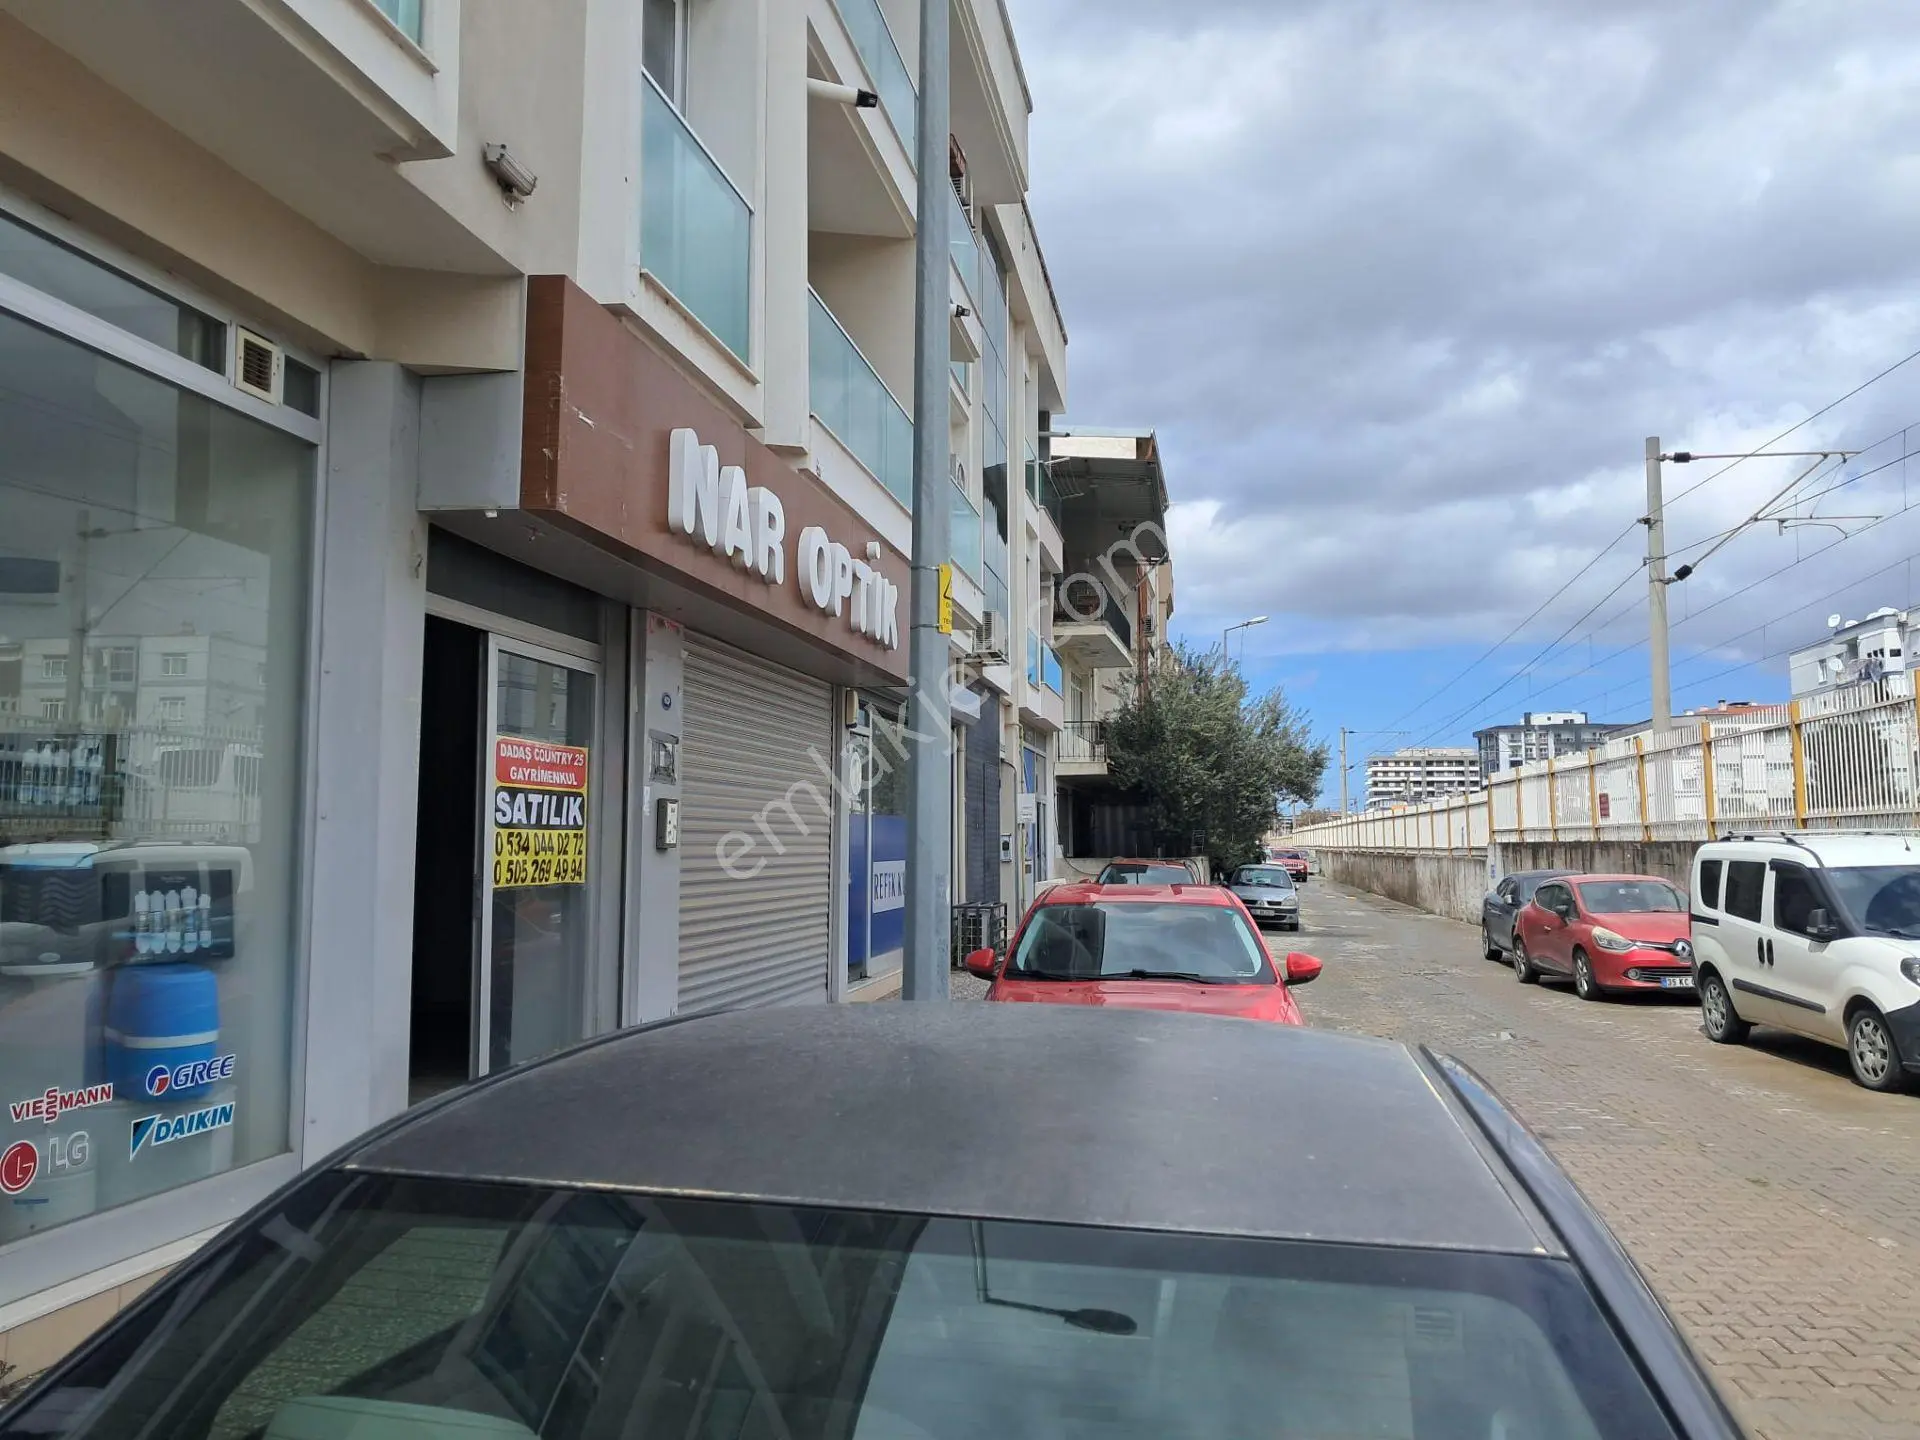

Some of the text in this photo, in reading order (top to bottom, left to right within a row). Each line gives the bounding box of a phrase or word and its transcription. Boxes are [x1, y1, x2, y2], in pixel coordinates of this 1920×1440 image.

[668, 428, 898, 650] NAR OPTİK
[500, 744, 584, 766] DADAŞ COUNTRY 25
[510, 766, 577, 785] GAYRİMENKUL
[495, 791, 583, 826] SATILIK
[495, 831, 503, 857] 0
[506, 831, 530, 857] 534
[573, 832, 584, 856] 72
[493, 858, 583, 886] 0 505 269 49 94
[873, 872, 896, 900] REFİK
[172, 1054, 236, 1090] GREE
[152, 1102, 235, 1146] DAIKIN
[48, 1131, 89, 1174] LG
